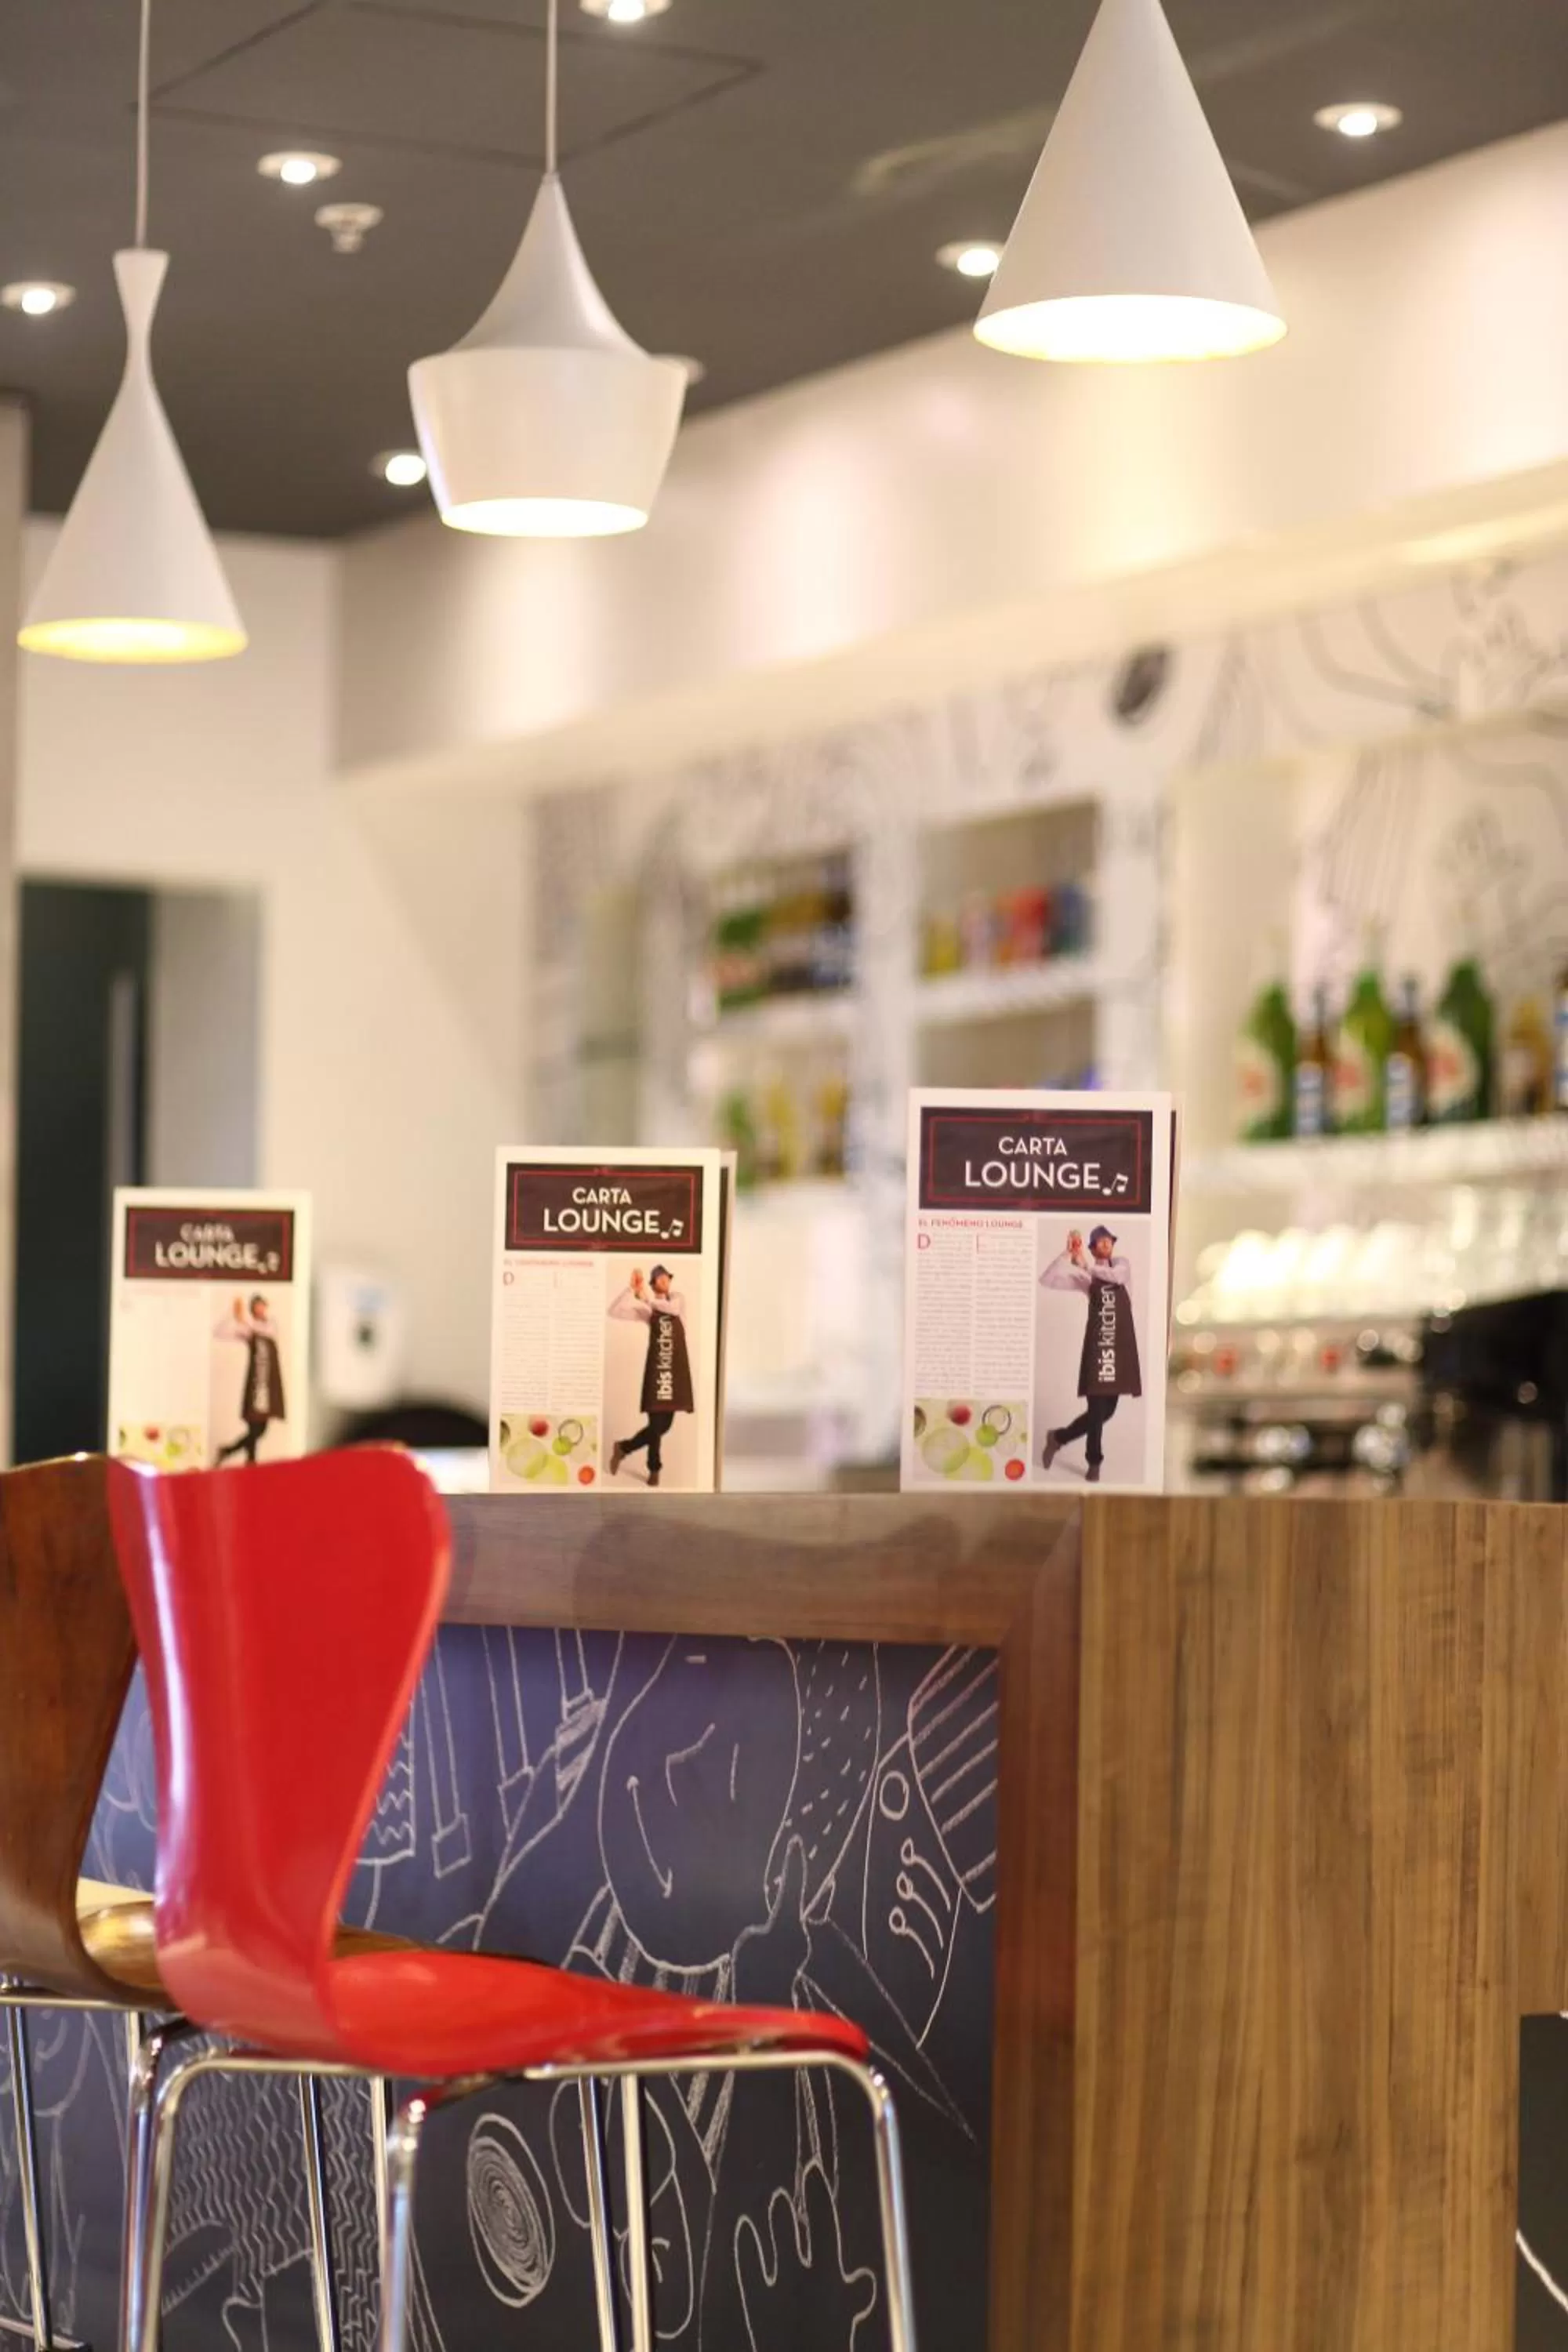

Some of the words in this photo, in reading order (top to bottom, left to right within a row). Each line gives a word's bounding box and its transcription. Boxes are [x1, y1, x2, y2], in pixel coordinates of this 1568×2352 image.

[998, 1136, 1067, 1156] CARTA
[964, 1160, 1101, 1189] LOUNGE
[572, 1186, 633, 1205] CARTA
[543, 1207, 660, 1233] LOUNGE
[154, 1240, 259, 1269] LOUNGE
[1098, 1285, 1116, 1346] kitchen
[1098, 1348, 1116, 1382] ibis
[657, 1370, 673, 1400] ibis
